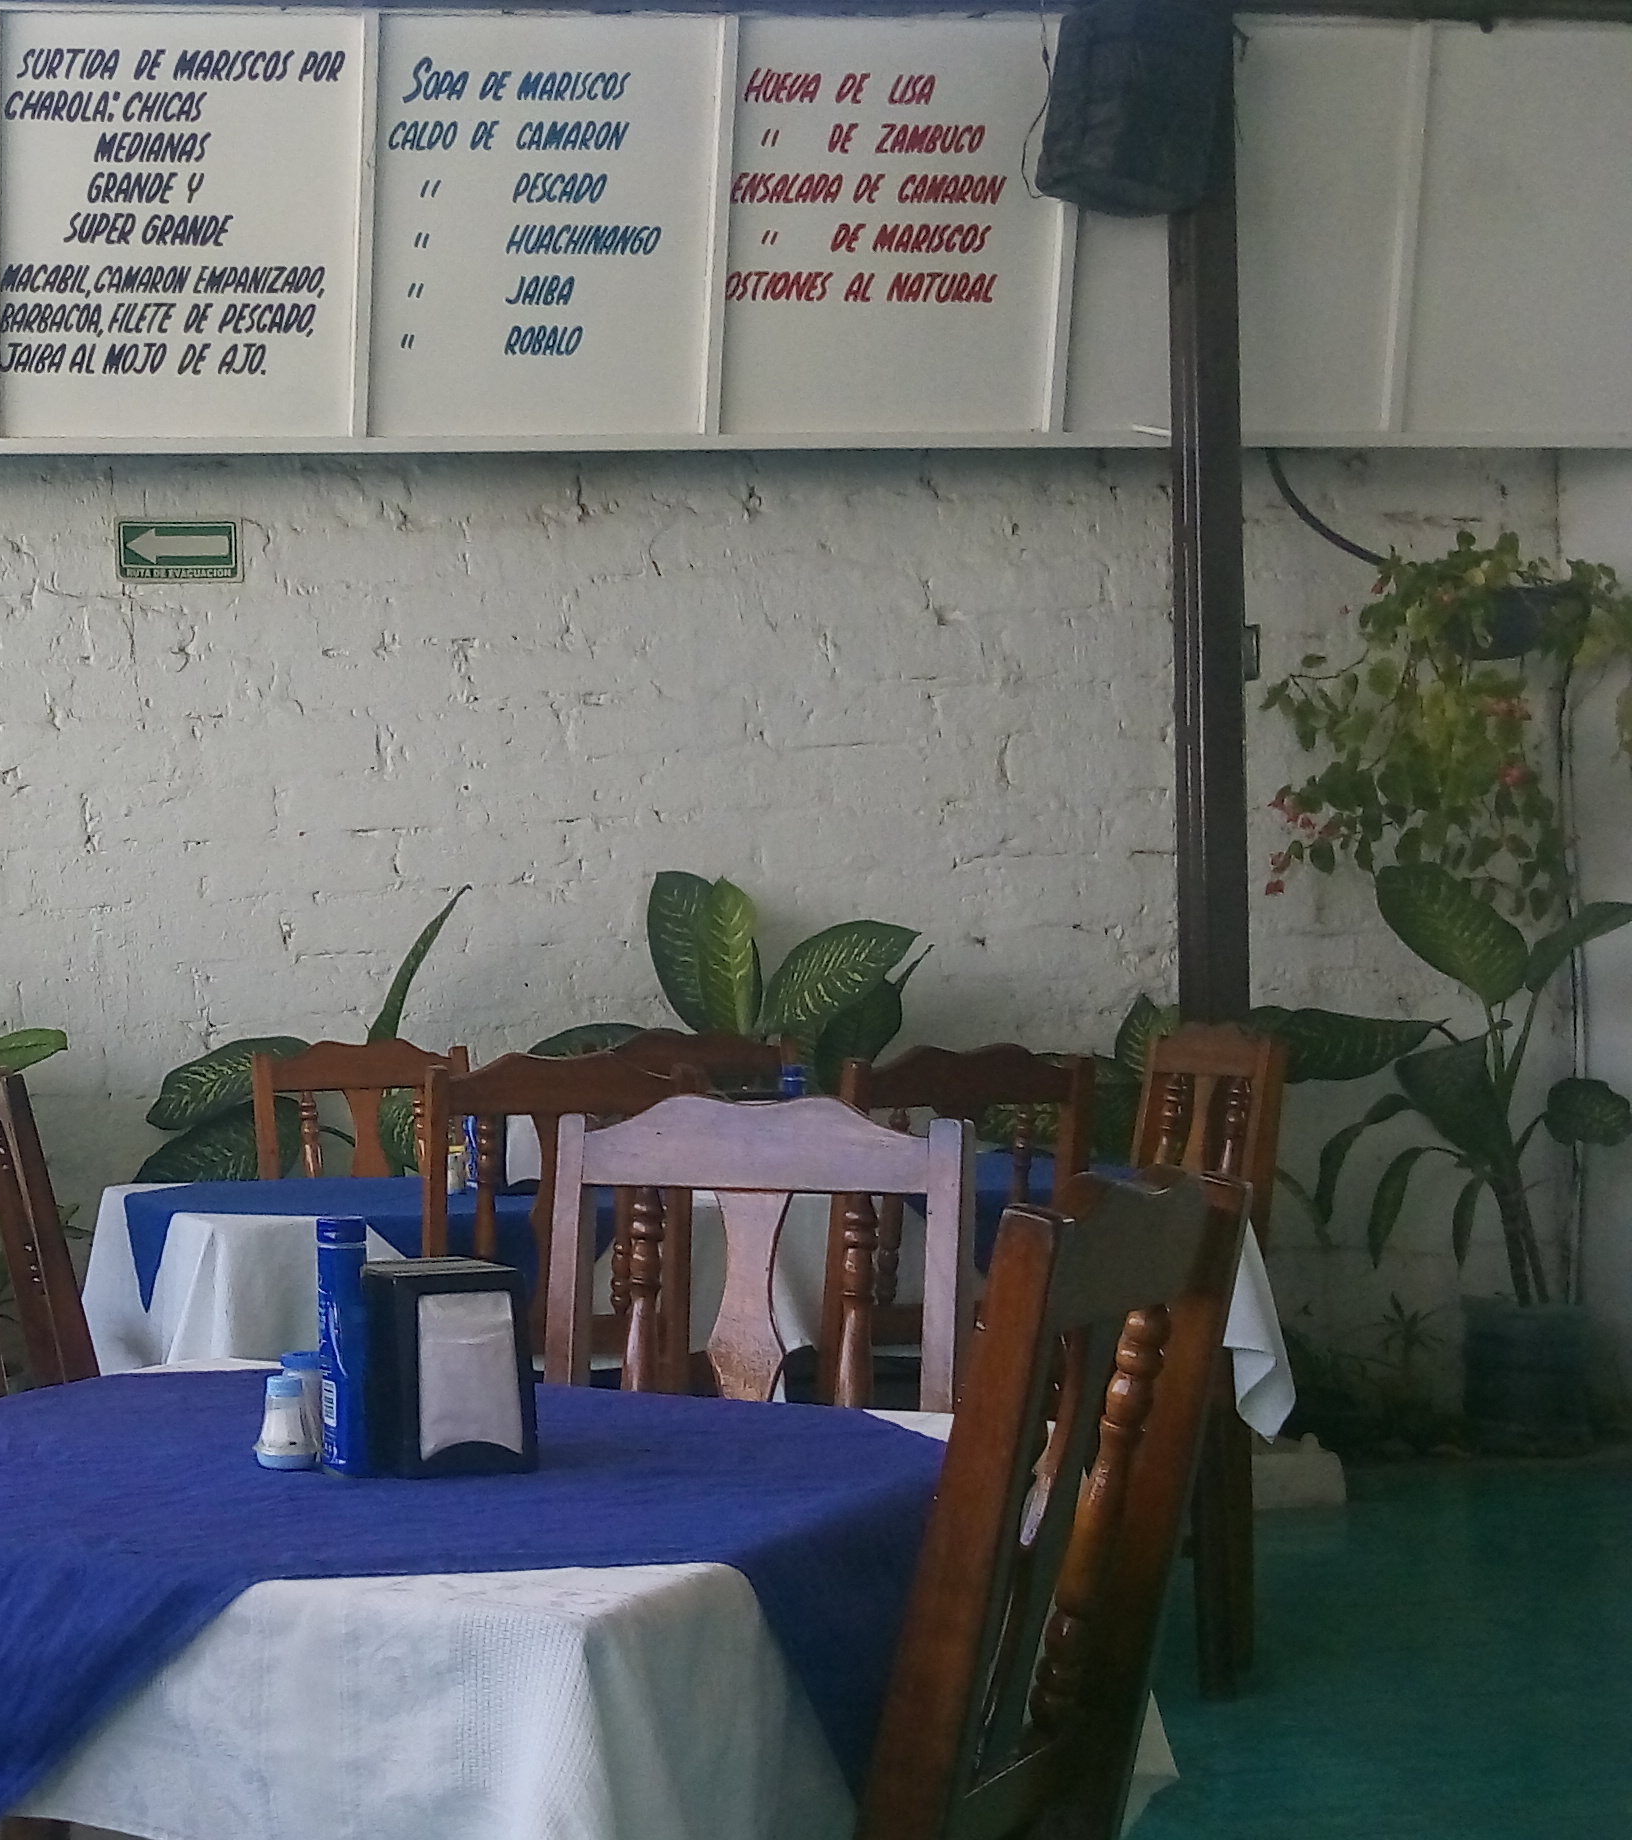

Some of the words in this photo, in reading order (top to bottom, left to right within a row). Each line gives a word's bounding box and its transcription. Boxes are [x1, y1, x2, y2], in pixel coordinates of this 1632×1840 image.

[17, 49, 120, 80] SURTIDA
[134, 49, 165, 80] DE
[172, 49, 295, 82] MARISCOS
[299, 50, 346, 82] POR
[479, 70, 512, 101] DE
[517, 71, 631, 101] MARISCOS
[835, 72, 871, 104] DE
[887, 74, 936, 105] LISA
[122, 91, 207, 122] CHICAS
[94, 132, 212, 163] MEDIANAS
[388, 120, 458, 151] CALDO
[469, 120, 500, 151] DE
[515, 121, 630, 152] CAMARON
[827, 122, 859, 153] DE
[874, 123, 986, 154] ZAMBUCO
[87, 172, 178, 204] GRANDE
[187, 173, 204, 204] Y
[512, 172, 608, 204] PESCADO
[729, 173, 843, 204] ENSALADA
[853, 173, 886, 204] DE
[897, 173, 1008, 205] CAMARON
[63, 212, 136, 245] SUPER
[141, 214, 233, 247] GRANDE
[506, 223, 662, 255] HUACHINANGO
[830, 223, 866, 253] DE
[872, 223, 993, 254] MARISCOS
[0, 263, 91, 299] MACABIL,
[93, 265, 191, 294] CAMARON
[193, 265, 326, 299] EMPANIZADO,
[504, 274, 575, 306] JAIBA
[725, 271, 834, 301] OSTIONES
[843, 272, 875, 303] AL
[886, 272, 999, 303] NATURAL
[0, 302, 104, 337] BARBACOA,
[107, 302, 176, 334] FILETE
[184, 303, 214, 334] DE
[217, 303, 317, 338] PESCADO,
[503, 325, 583, 356] ROBALO
[0, 342, 66, 375] JAIBA
[69, 343, 96, 374] AL
[102, 343, 167, 376] MOJO
[177, 343, 211, 376] DE
[218, 343, 267, 376] AJO.
[126, 568, 152, 578] RUTA
[153, 569, 167, 578] DE
[168, 569, 231, 578] EVACUACION
